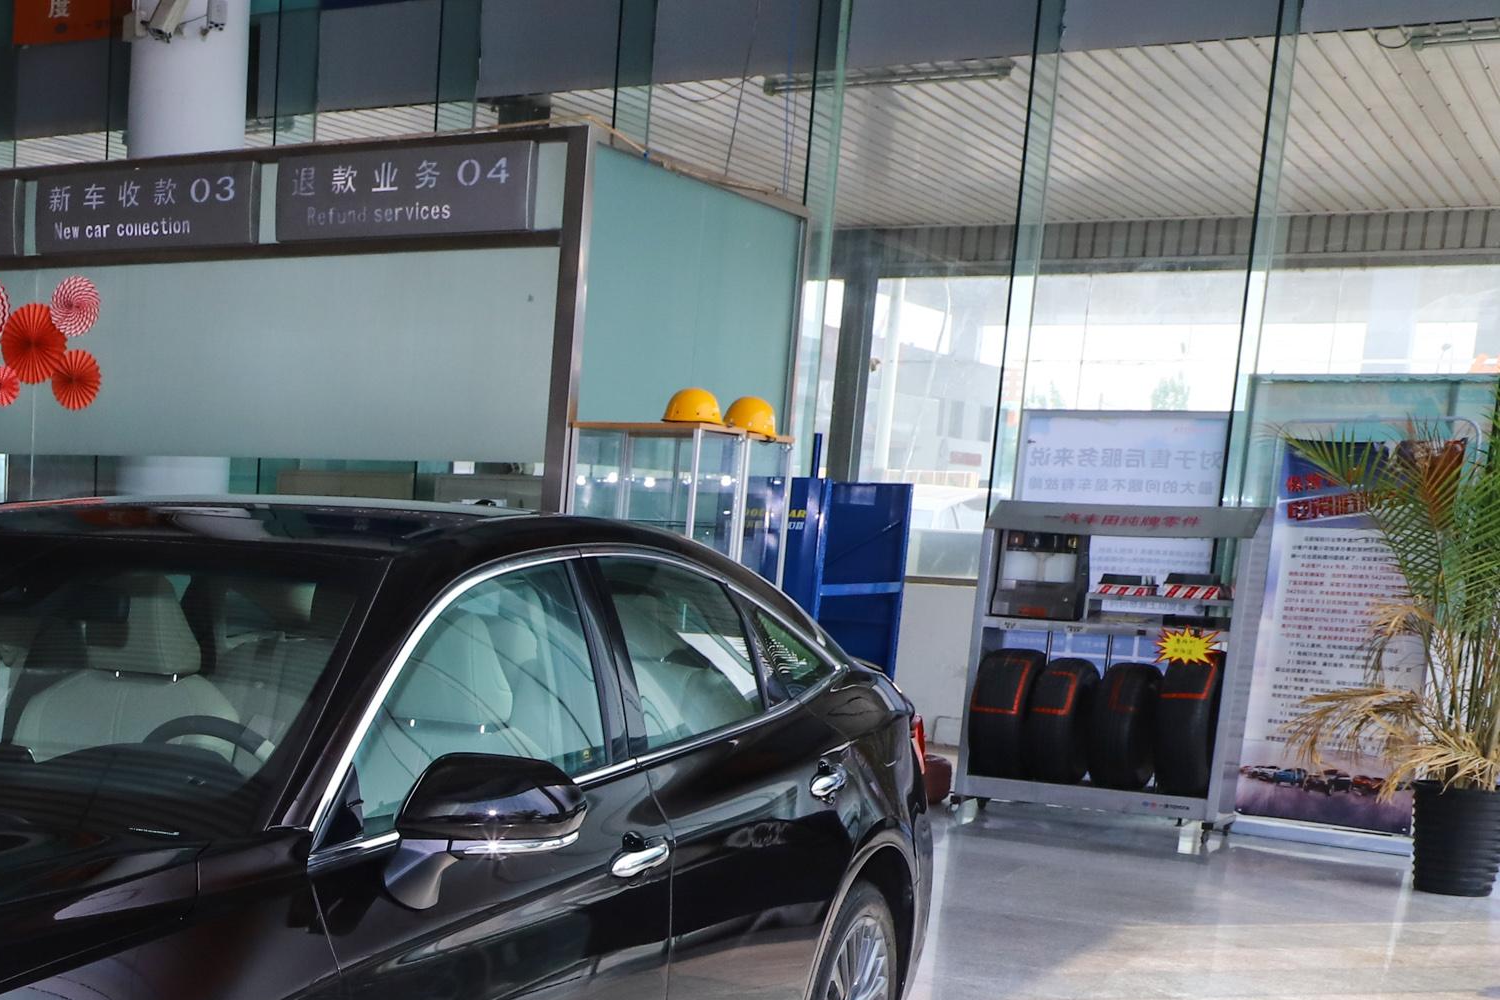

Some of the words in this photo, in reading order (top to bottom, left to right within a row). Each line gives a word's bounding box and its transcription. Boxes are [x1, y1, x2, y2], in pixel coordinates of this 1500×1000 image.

[292, 160, 441, 196] 退款业务
[457, 157, 511, 186] 04
[49, 178, 177, 212] 新车收款
[189, 176, 235, 203] 03
[307, 206, 367, 226] Refund
[374, 202, 451, 223] services
[54, 221, 80, 240] New
[85, 223, 110, 239] car
